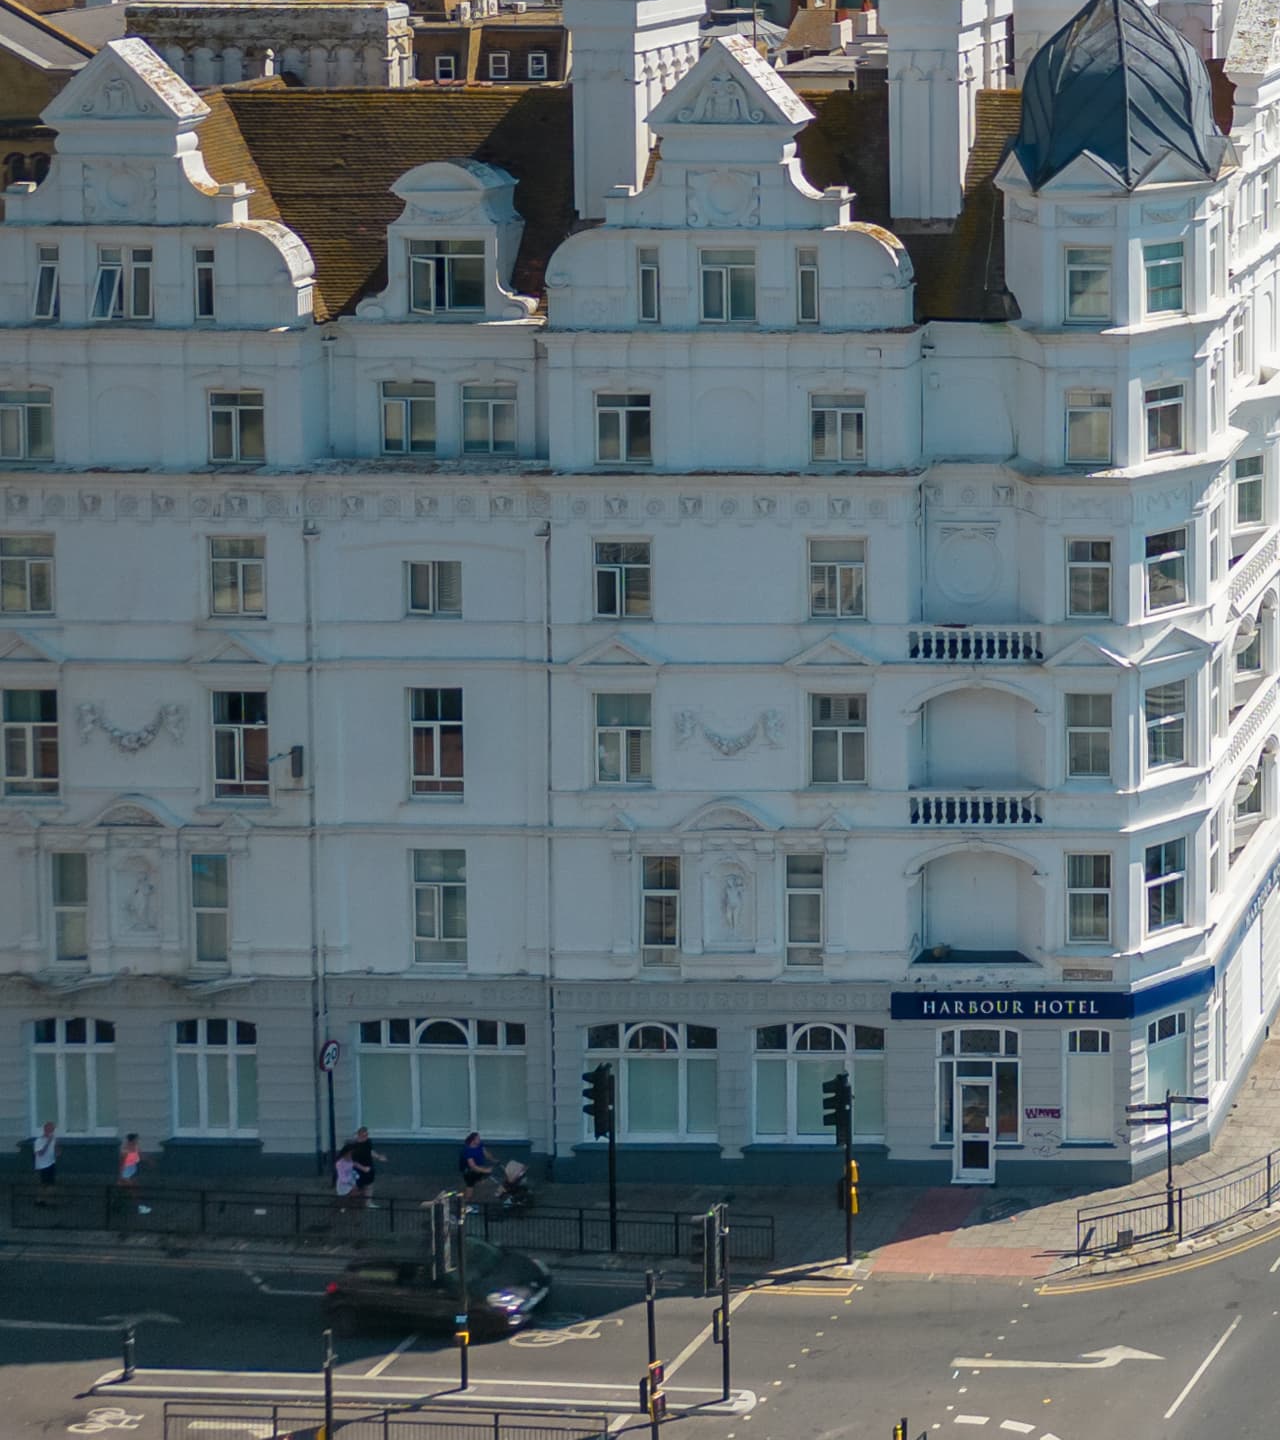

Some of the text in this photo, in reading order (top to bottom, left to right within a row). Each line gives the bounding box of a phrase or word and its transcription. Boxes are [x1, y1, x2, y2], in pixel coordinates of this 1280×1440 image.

[923, 999, 1099, 1015] HARBOUR HOTEL
[325, 1046, 337, 1065] 20
